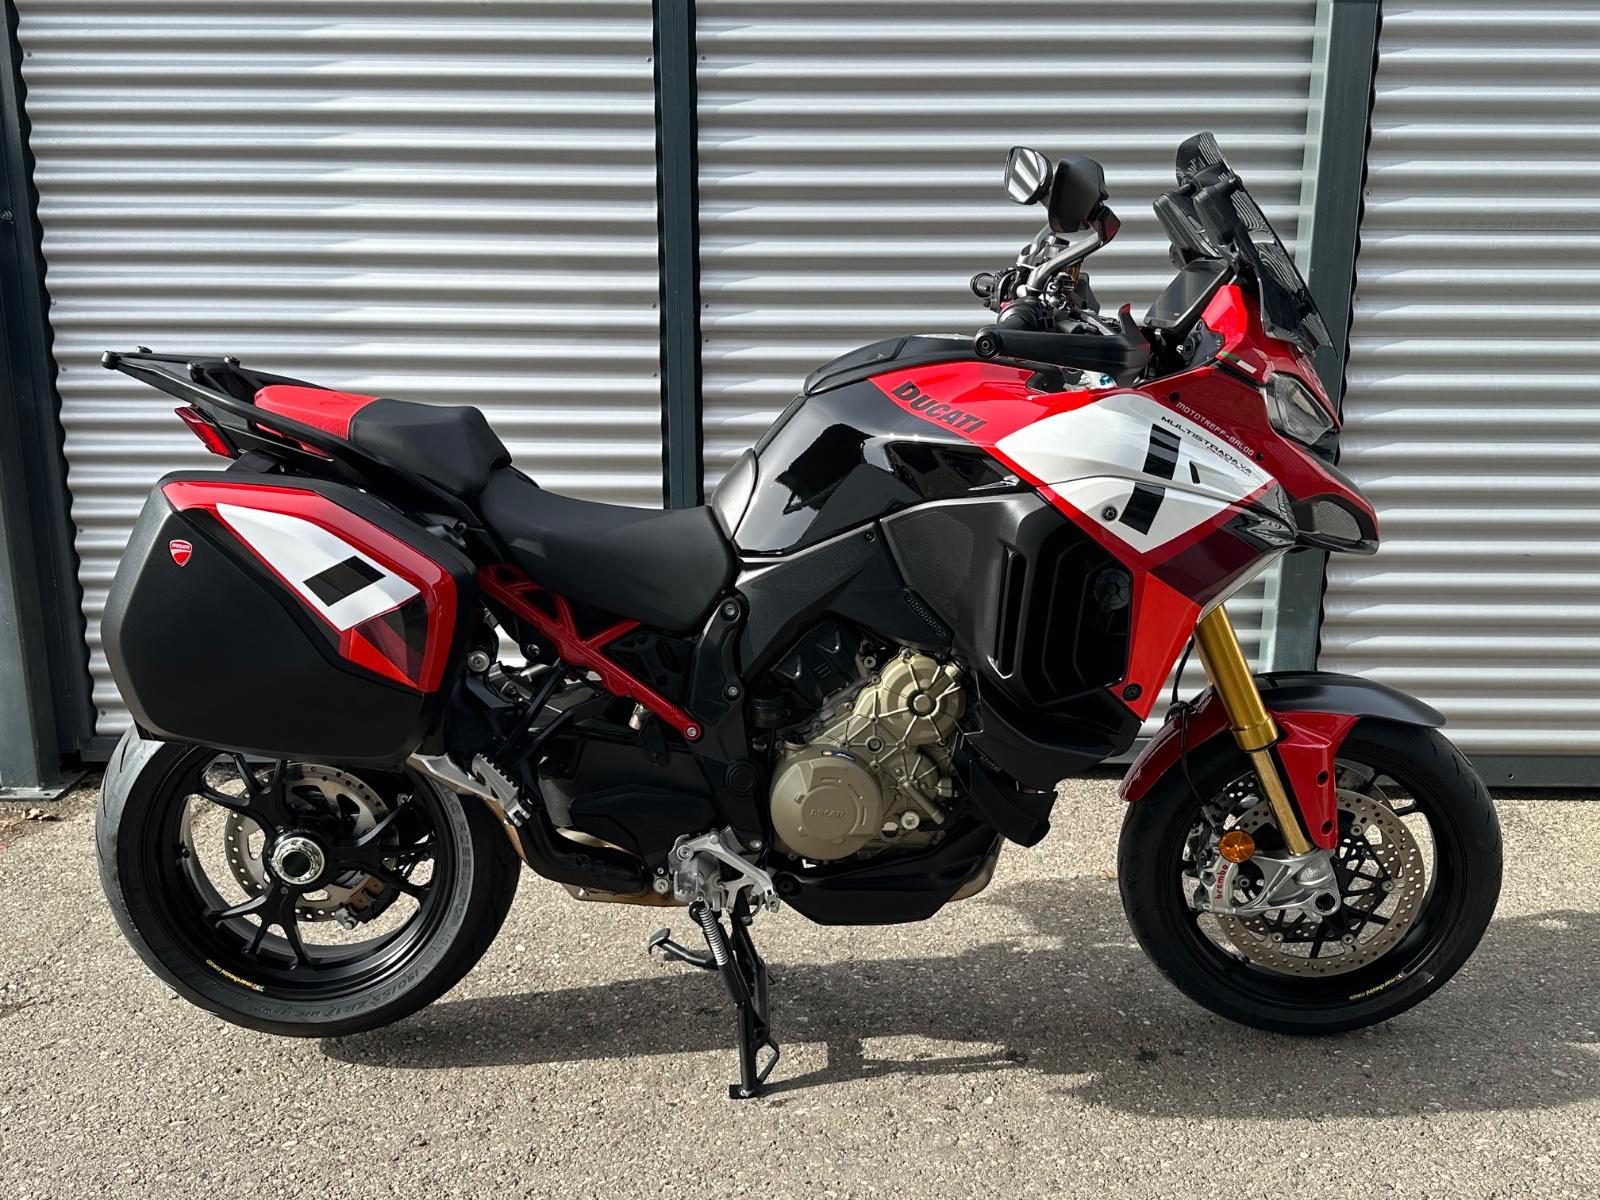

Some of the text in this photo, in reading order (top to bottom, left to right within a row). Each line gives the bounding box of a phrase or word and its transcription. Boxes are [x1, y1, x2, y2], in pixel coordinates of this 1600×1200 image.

[891, 380, 988, 433] DUCATI
[1175, 401, 1254, 457] MOTOTREFF-BALOG
[1161, 416, 1239, 465] MULTISTRADA
[809, 808, 846, 818] DUCATI
[1214, 863, 1229, 900] brembo
